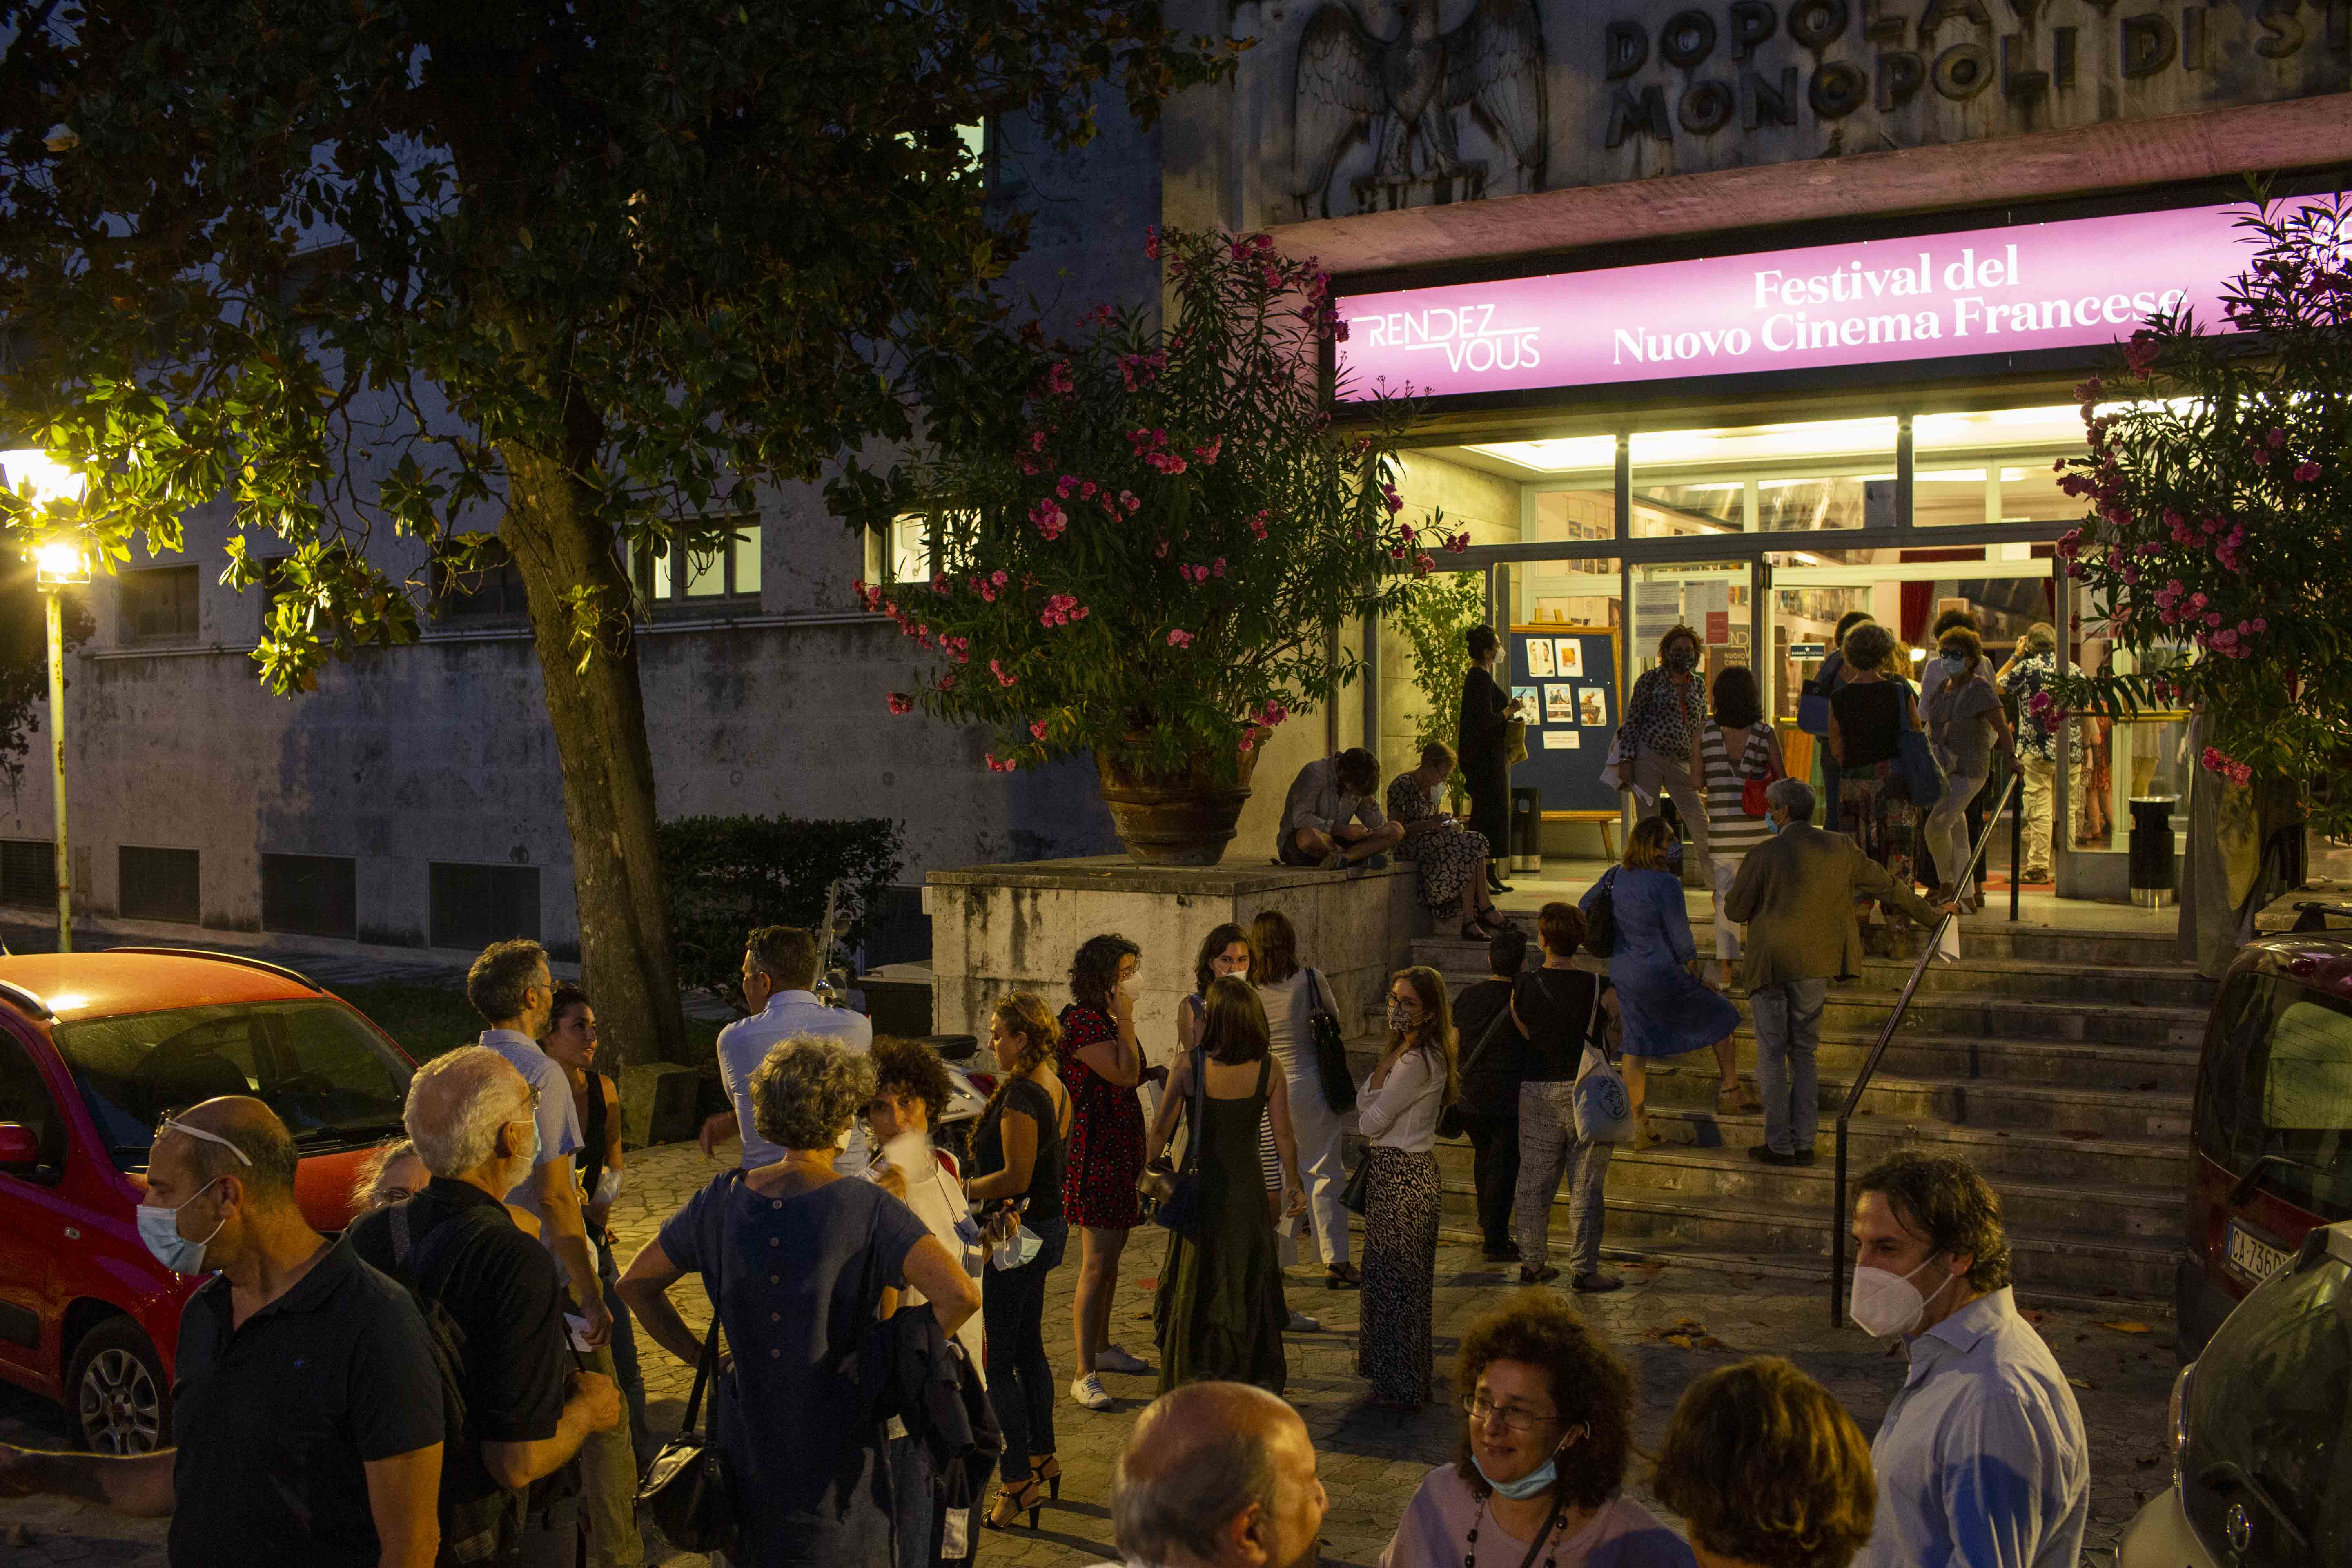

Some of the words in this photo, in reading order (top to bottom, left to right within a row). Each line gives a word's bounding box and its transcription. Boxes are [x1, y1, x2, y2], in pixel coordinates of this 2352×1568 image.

[1606, 26, 2077, 149] MONOPOLI
[2119, 6, 2207, 80] DI
[1753, 252, 1932, 310] Festival
[1943, 244, 2019, 292] del
[1352, 303, 1540, 350] RENDEZ
[1405, 332, 1540, 373] VOUS
[1613, 326, 1751, 364] Nuovo
[1762, 310, 1940, 352] Cinema
[1953, 286, 2188, 336] Francese
[2233, 1230, 2244, 1263] CA
